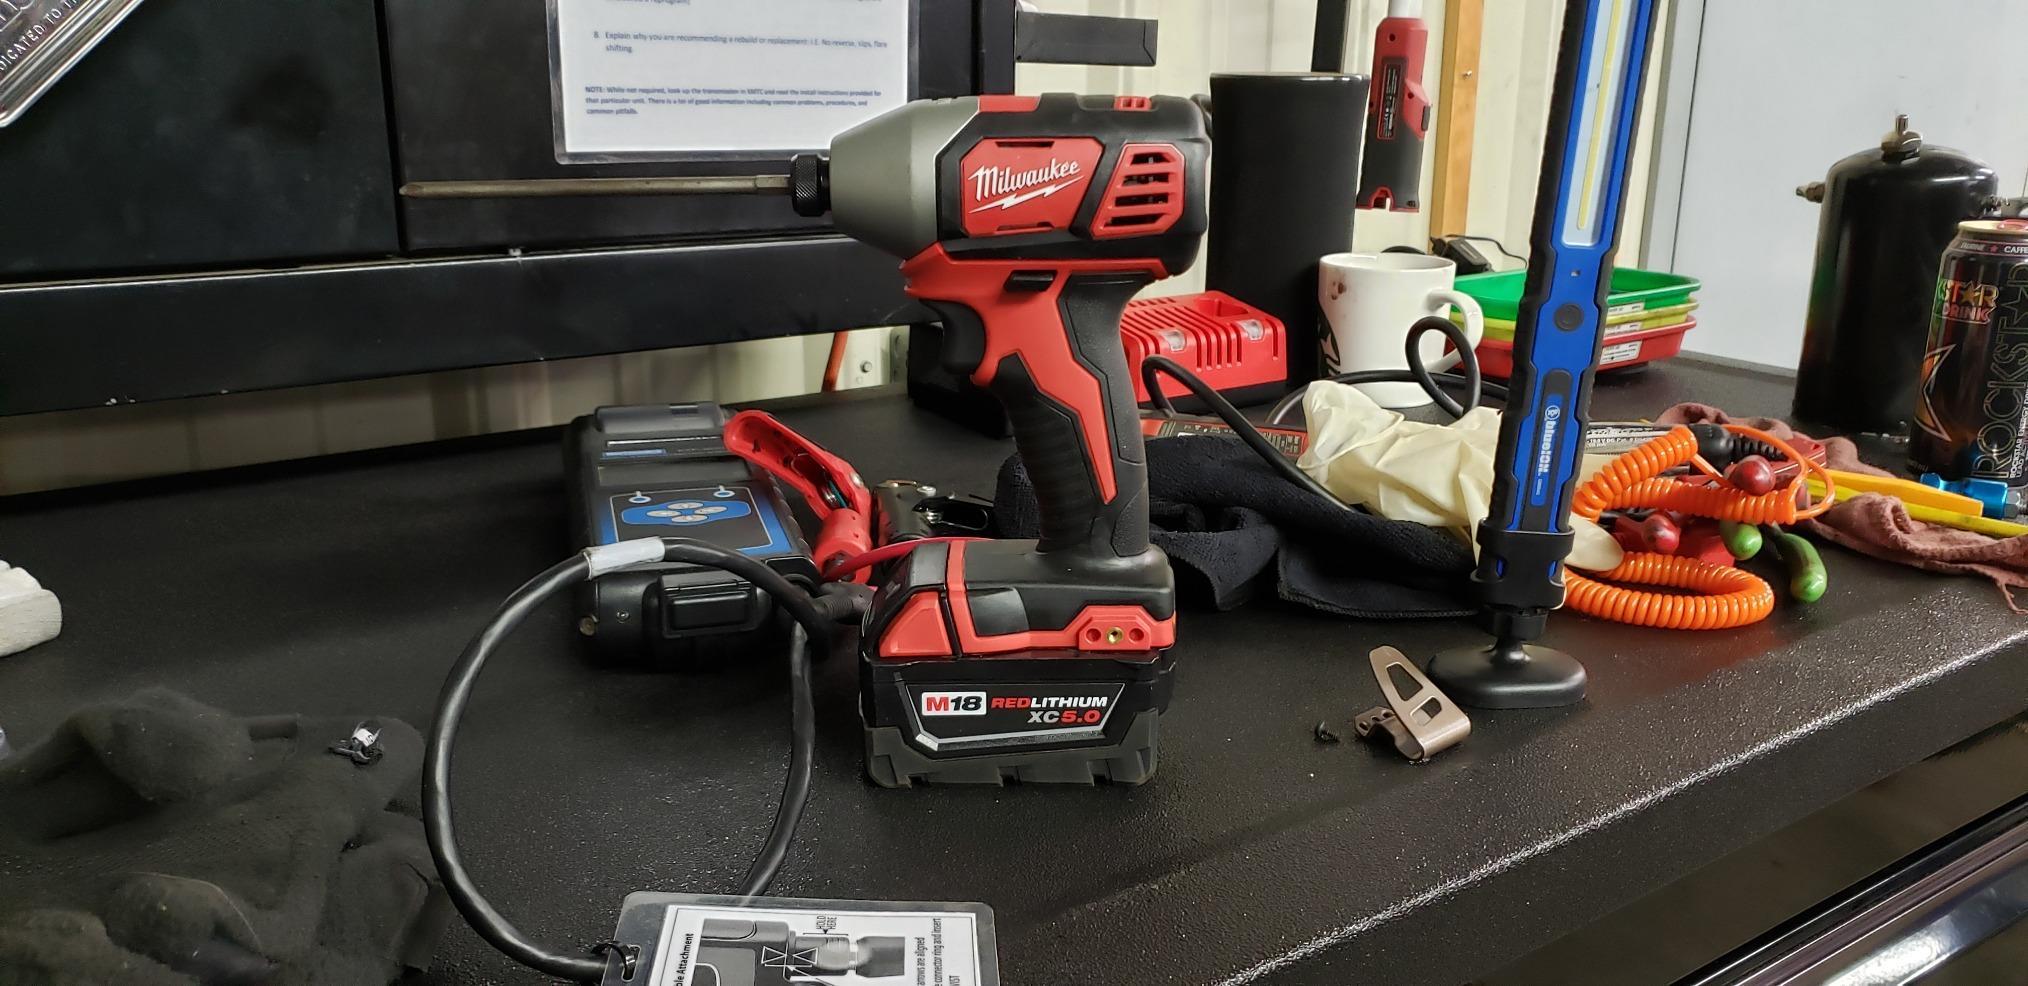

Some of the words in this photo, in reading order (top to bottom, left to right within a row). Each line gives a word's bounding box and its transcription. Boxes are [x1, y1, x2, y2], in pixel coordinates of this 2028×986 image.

[605, 31, 631, 41] Explain
[648, 34, 663, 42] you
[968, 158, 1081, 202] Milwaukee
[1942, 302, 1990, 322] DRINK
[926, 696, 983, 712] M18
[991, 697, 1108, 708] REDLITHIUM
[1027, 710, 1102, 724] XC5.0
[815, 915, 826, 929] HOLD
[826, 917, 837, 930] HERE
[931, 918, 942, 933] insert
[931, 934, 942, 944] and
[676, 933, 694, 974] Attachment
[914, 937, 928, 957] aligned
[932, 945, 945, 956] ring
[933, 957, 942, 983] connector
